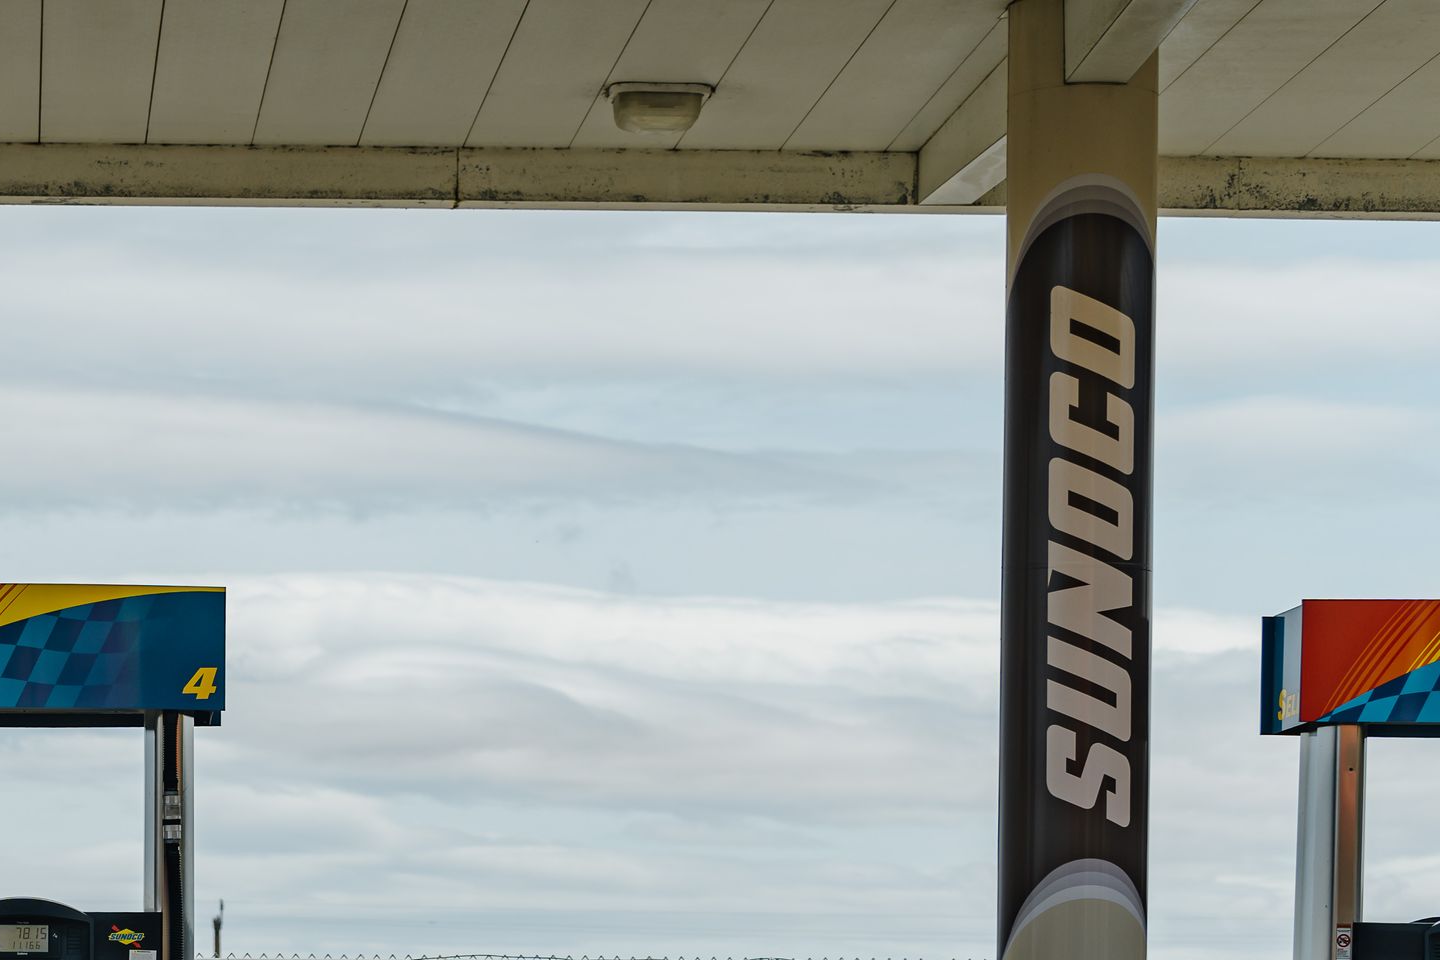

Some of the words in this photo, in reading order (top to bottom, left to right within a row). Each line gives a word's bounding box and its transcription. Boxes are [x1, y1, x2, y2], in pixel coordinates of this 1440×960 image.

[1046, 284, 1136, 828] SUNOCO
[182, 667, 218, 700] 4
[109, 933, 144, 941] SUNOCO
